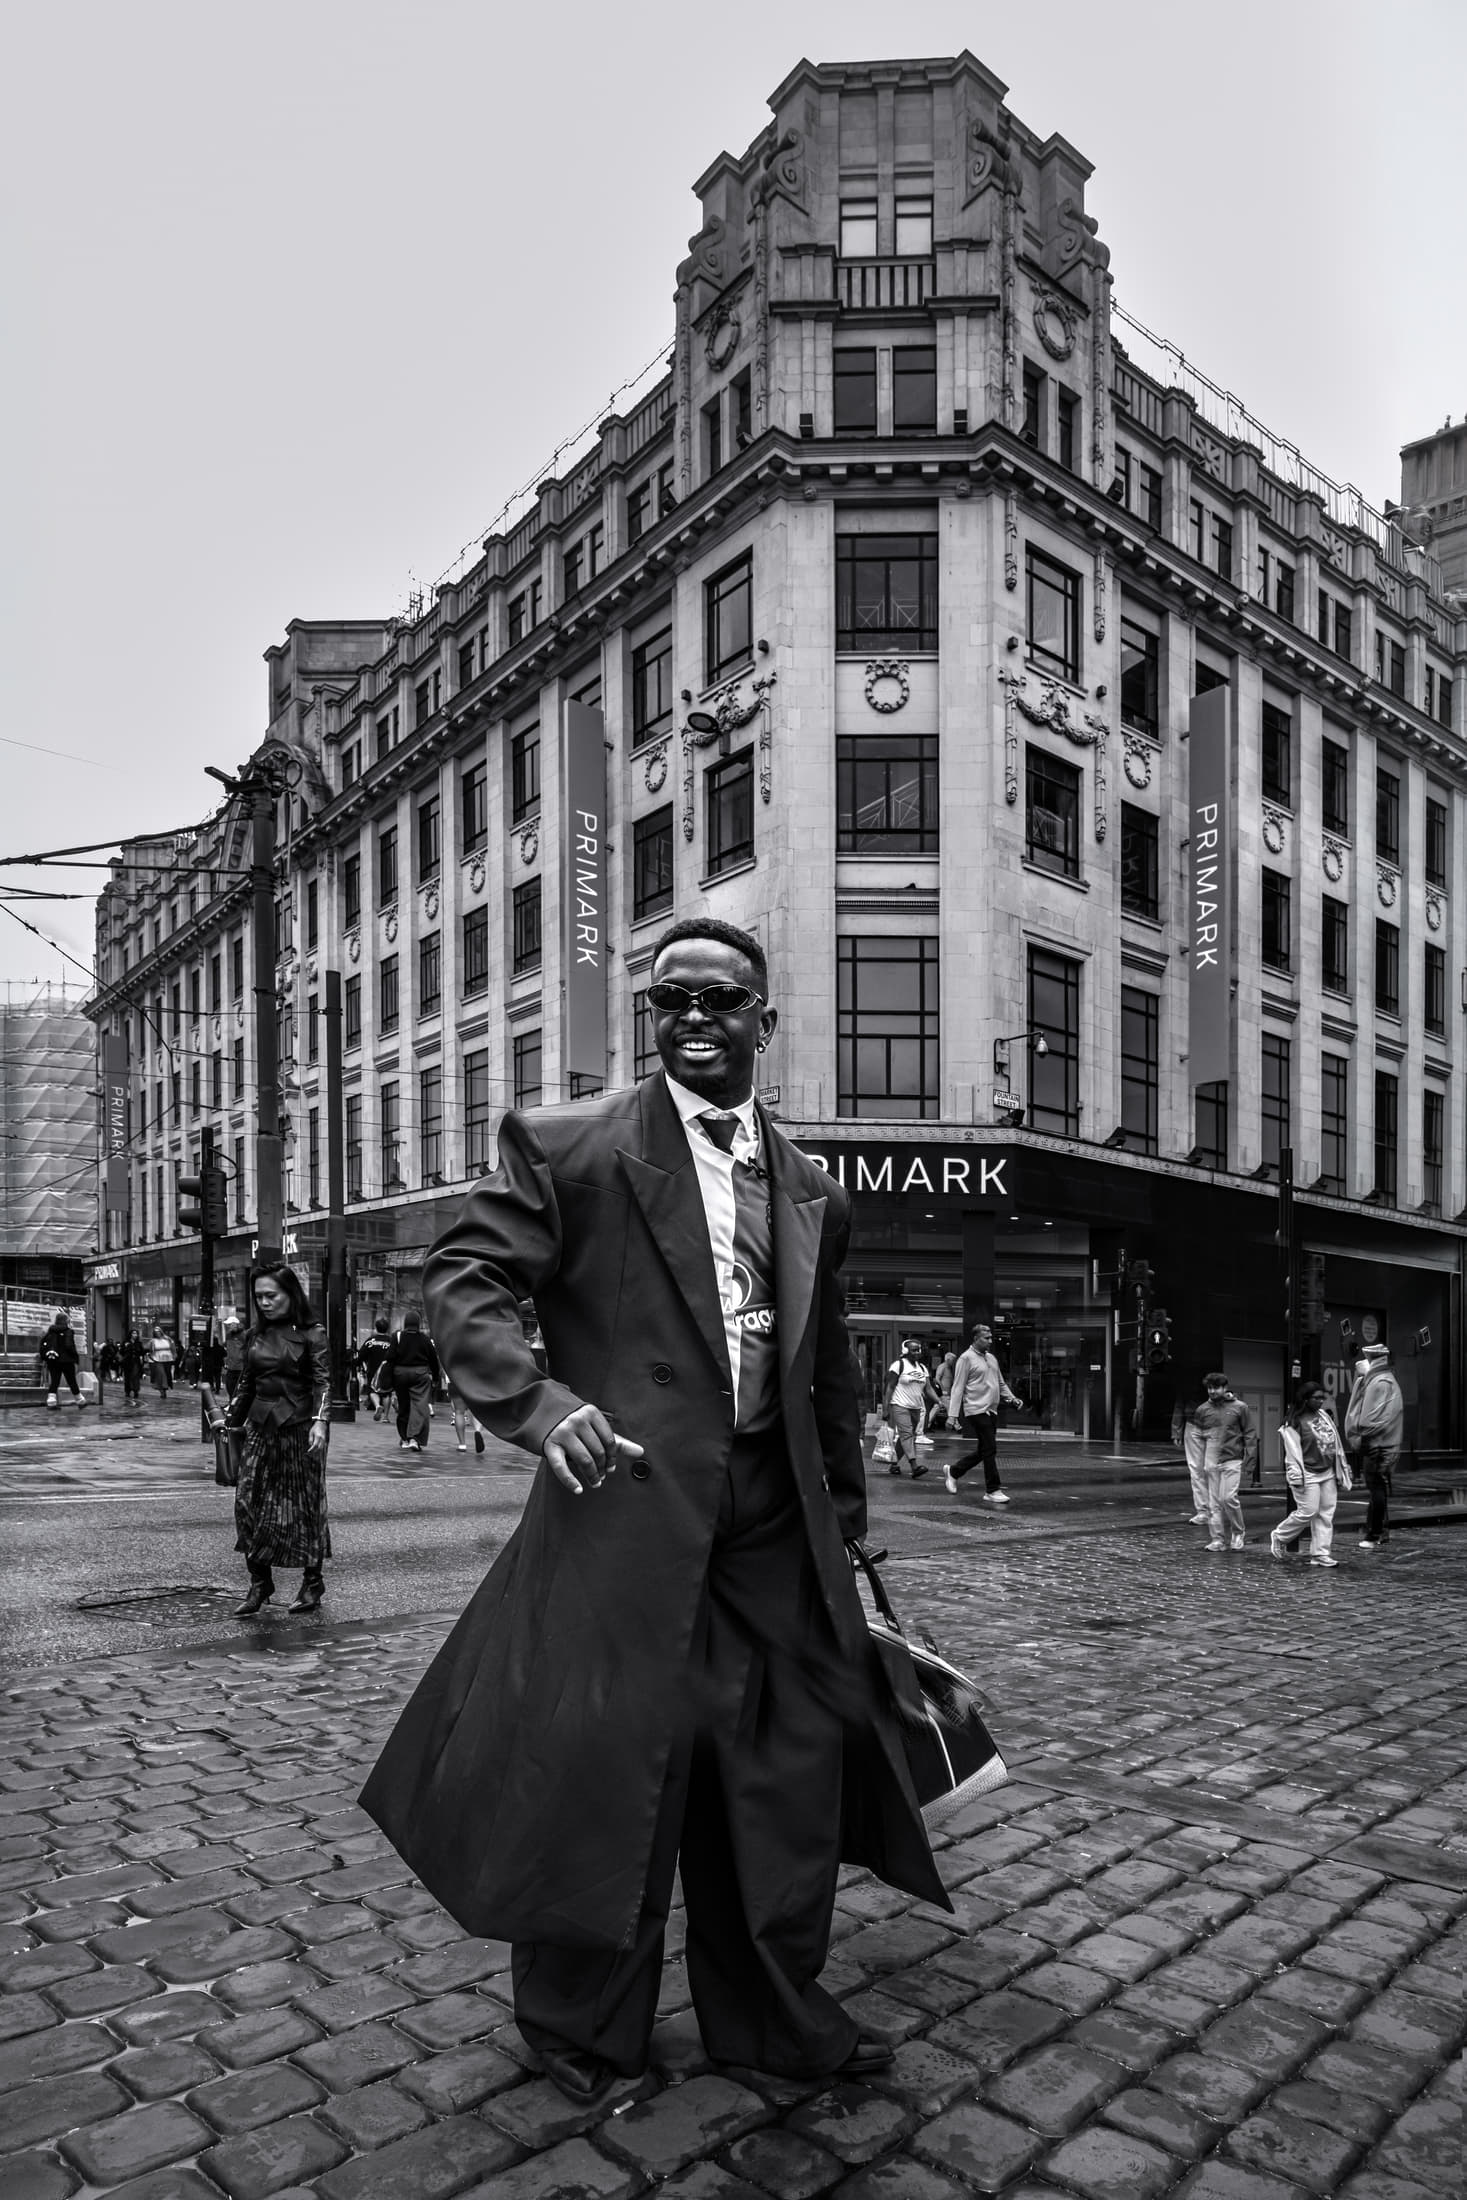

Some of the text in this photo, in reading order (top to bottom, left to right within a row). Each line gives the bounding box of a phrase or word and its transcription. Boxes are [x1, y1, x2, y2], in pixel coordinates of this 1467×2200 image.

[576, 809, 598, 968] PRIMARK
[1196, 803, 1218, 970] PRIMARK
[111, 1086, 124, 1160] PRIMARK
